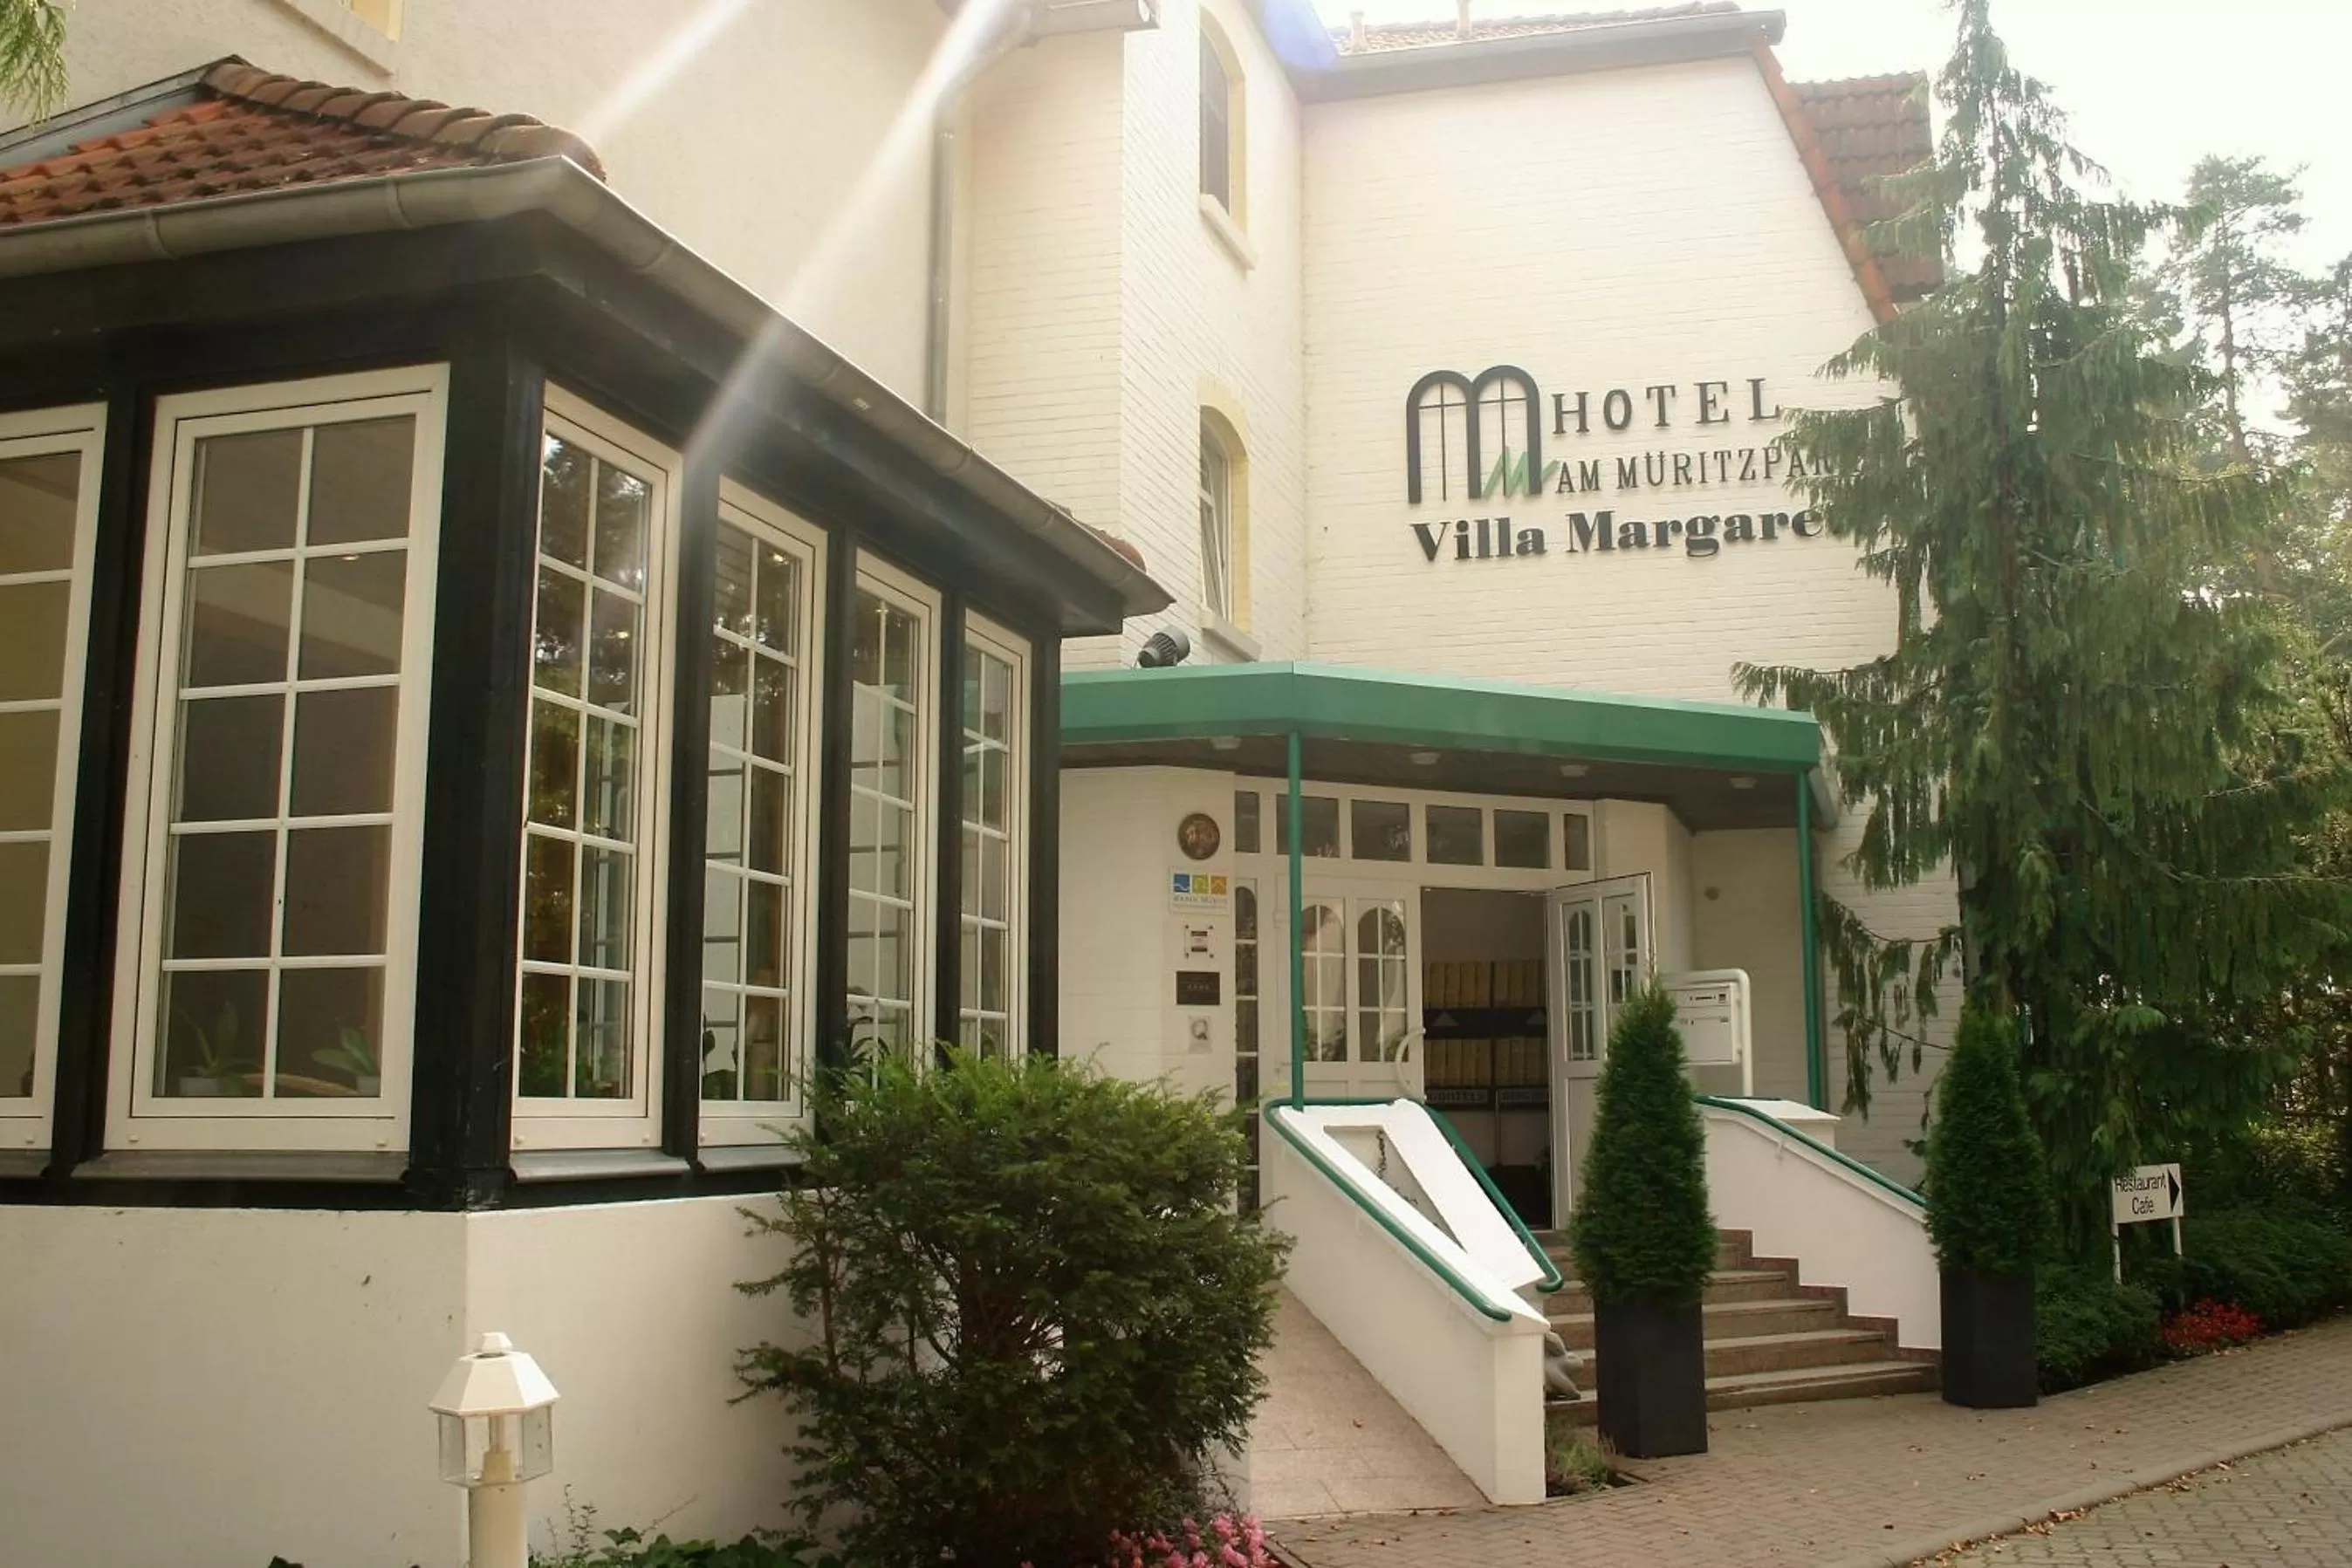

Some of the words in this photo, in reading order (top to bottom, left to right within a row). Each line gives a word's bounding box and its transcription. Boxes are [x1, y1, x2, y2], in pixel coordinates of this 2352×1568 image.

[1552, 378, 1780, 435] HOTEL
[1555, 459, 1601, 493] AM
[1615, 444, 1836, 490] MÜRITZPAR
[1409, 517, 1547, 562] Villa
[1566, 508, 1824, 558] Margare
[2115, 1172, 2166, 1193] Restaurant
